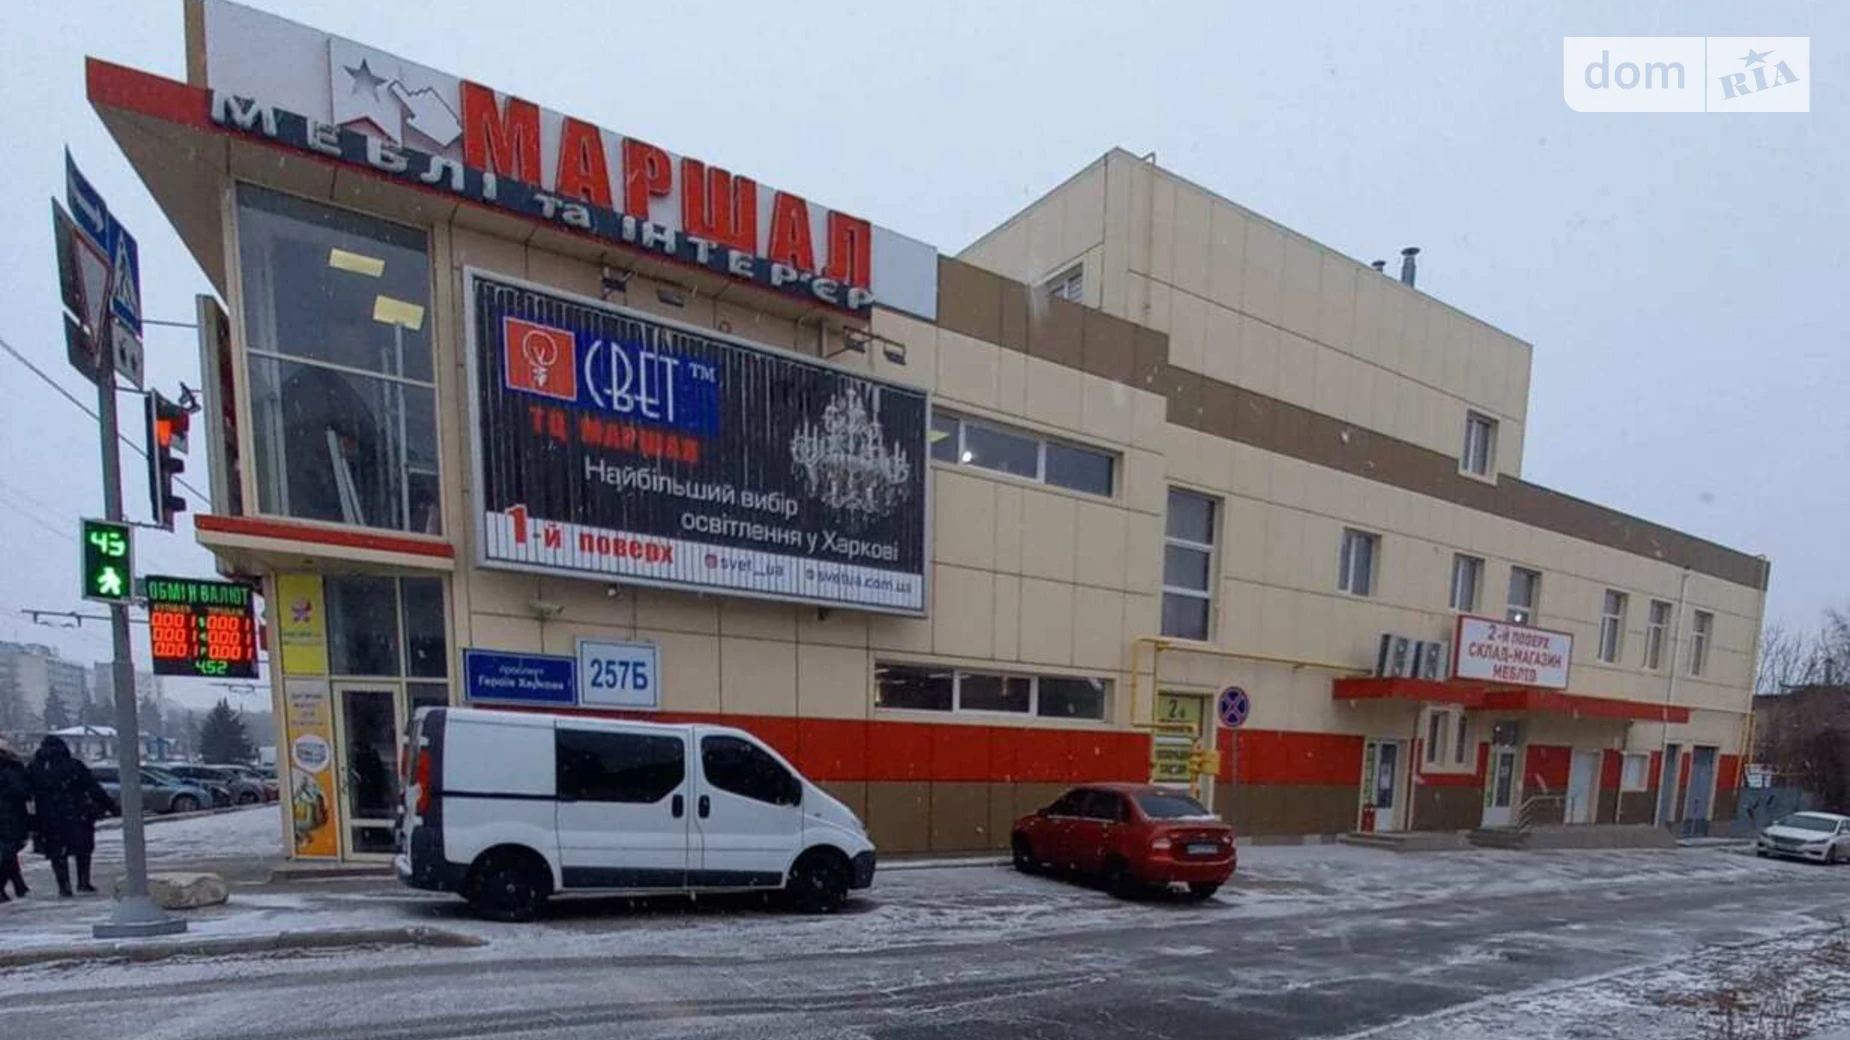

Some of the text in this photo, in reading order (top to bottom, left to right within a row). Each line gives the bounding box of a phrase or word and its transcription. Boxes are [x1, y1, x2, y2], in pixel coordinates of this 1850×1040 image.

[210, 88, 498, 200] МЕБЛІ
[533, 193, 590, 229] та
[460, 80, 872, 290] МАРШАЛ
[583, 340, 679, 422] СВЕТ
[579, 415, 699, 463] МАРШАЛ
[585, 456, 799, 520] Найбільший вибір
[506, 505, 674, 565] 1-й поверх
[681, 512, 899, 562] освітлення у Харкові
[200, 584, 248, 606] ВАЛЮТ
[591, 658, 648, 690] 257Б
[1468, 641, 1562, 668] СКЛАД-МАГАЗИН
